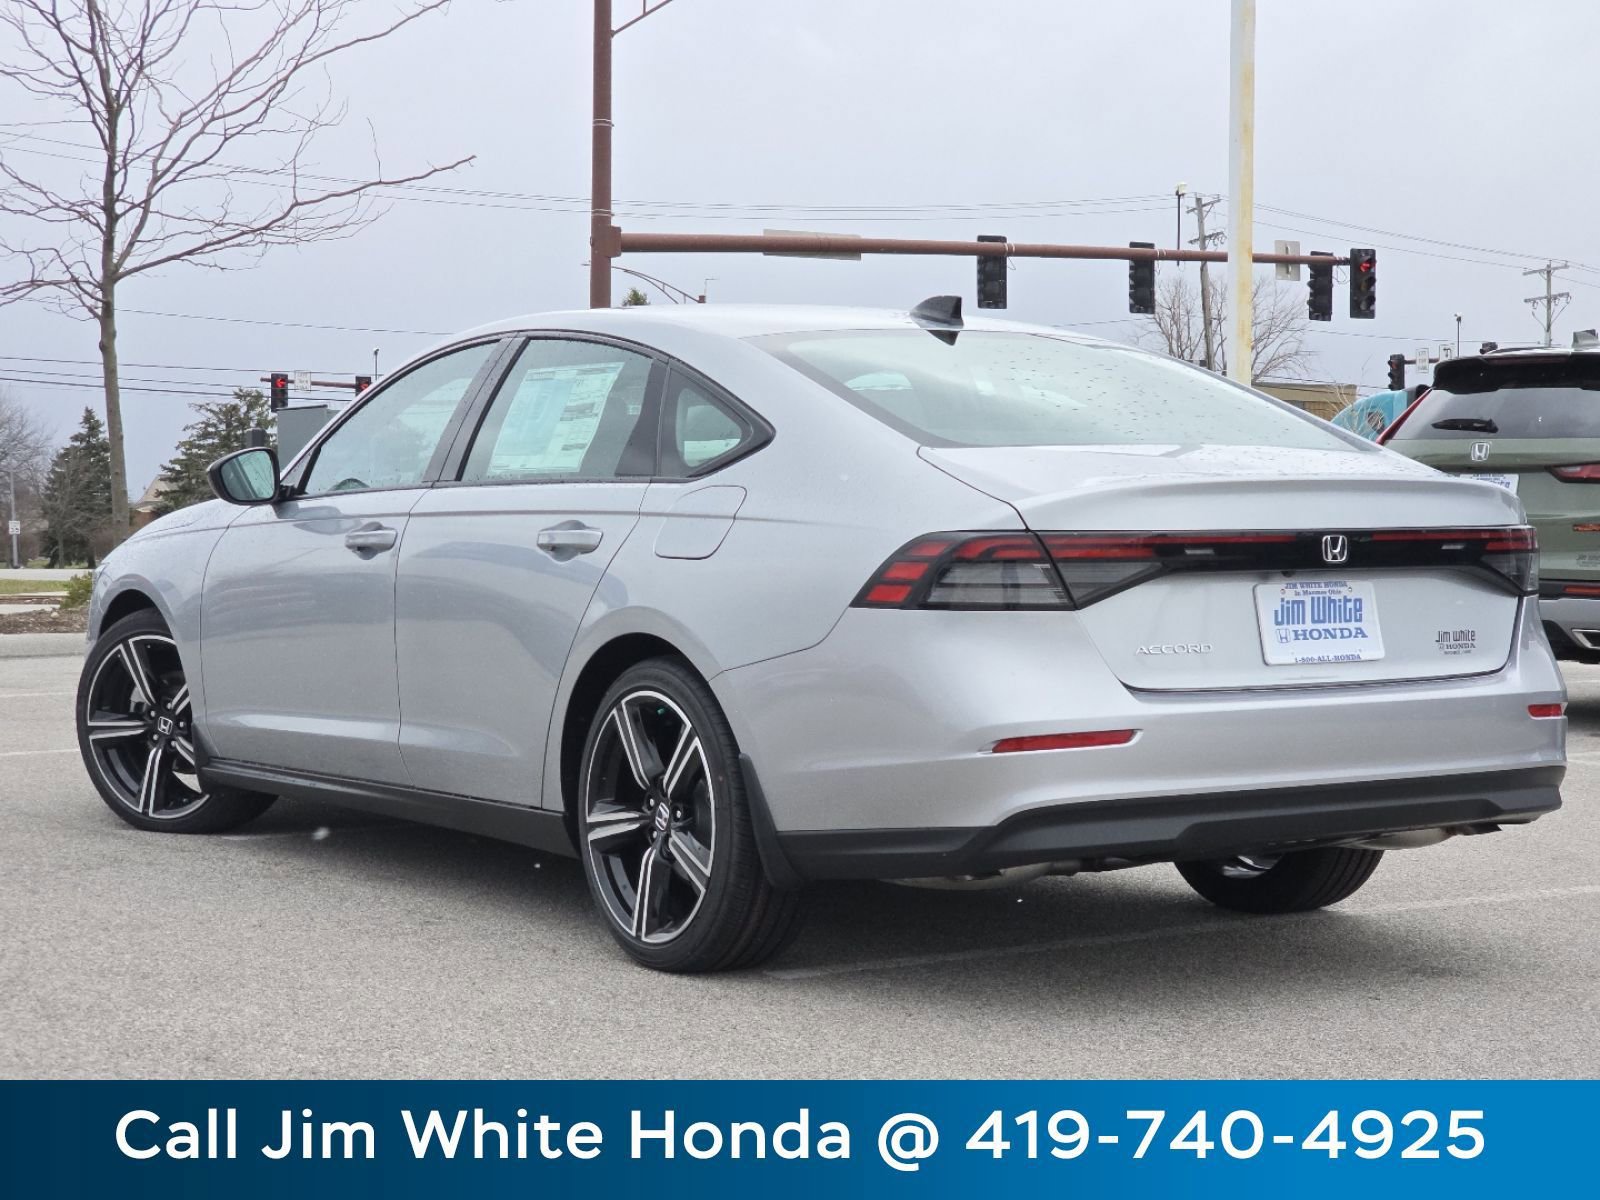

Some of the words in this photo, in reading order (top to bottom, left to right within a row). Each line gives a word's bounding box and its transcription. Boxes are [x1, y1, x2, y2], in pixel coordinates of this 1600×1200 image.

[1323, 581, 1348, 589] HONDA
[1274, 597, 1306, 626] Jim
[1310, 595, 1363, 624] White
[1292, 627, 1369, 641] HONDA
[1435, 630, 1451, 643] Jim
[1135, 643, 1212, 655] ACCORD
[1294, 653, 1362, 663] 1-800-ALL-HONDA
